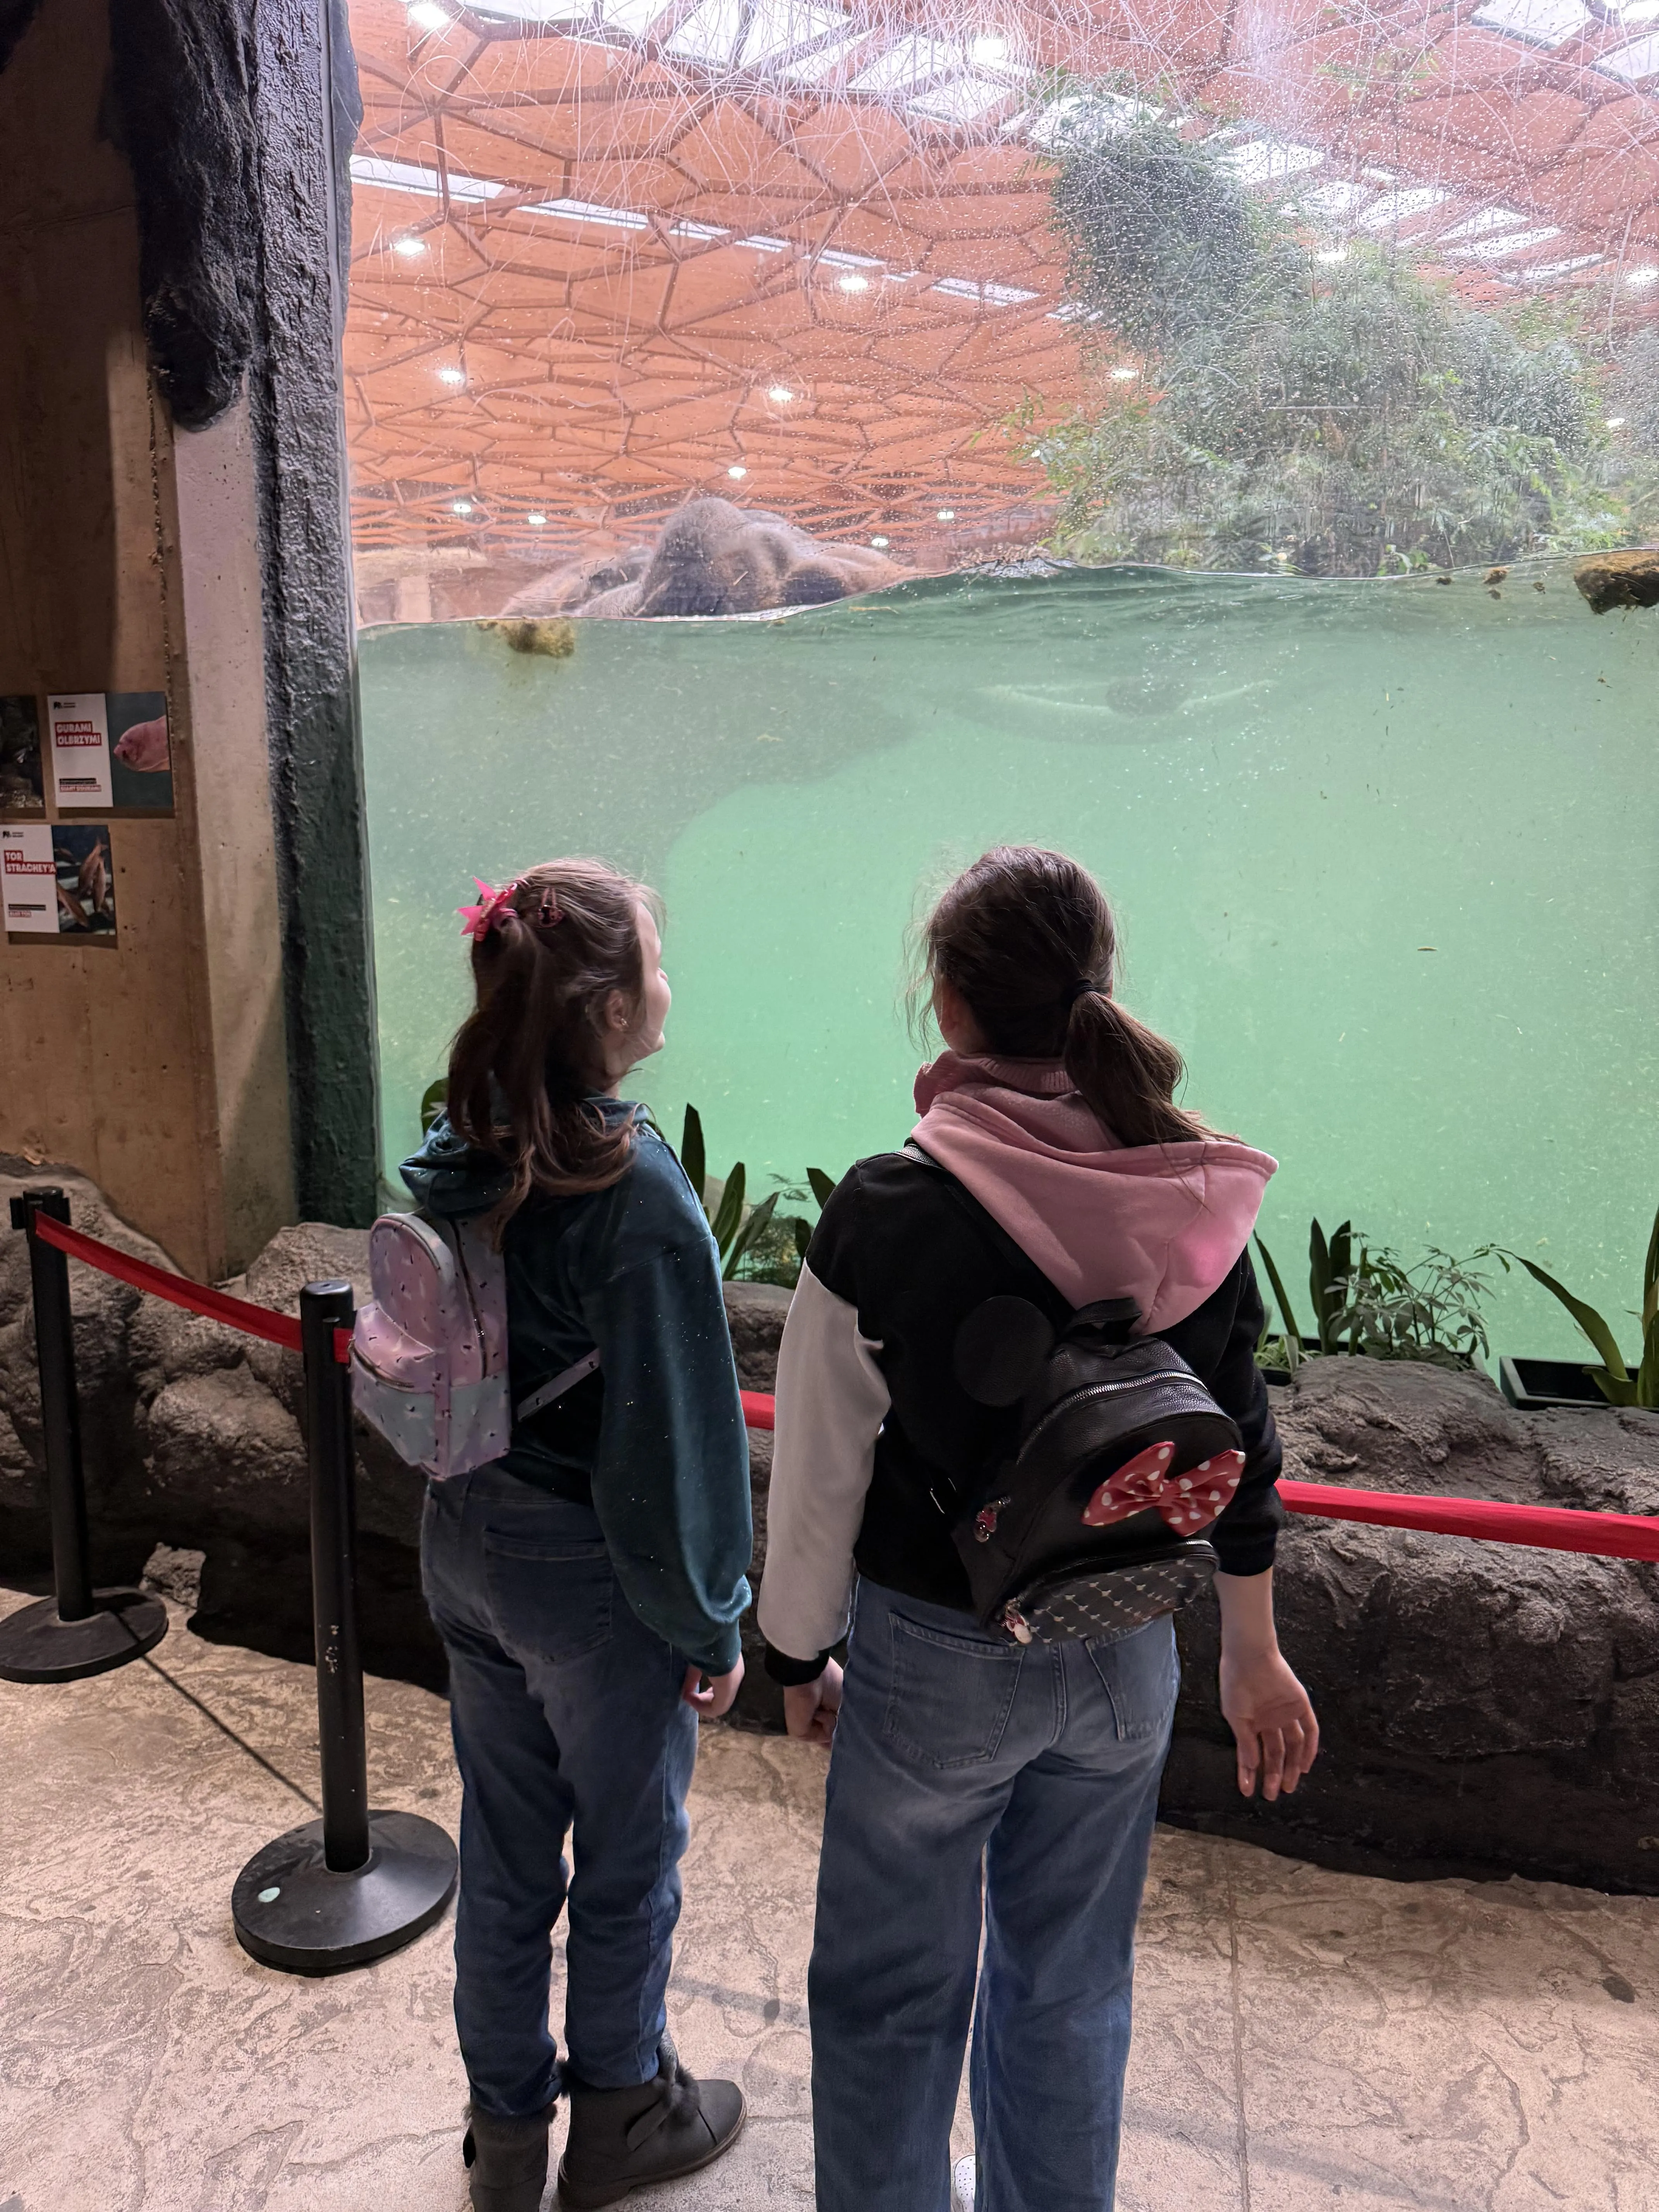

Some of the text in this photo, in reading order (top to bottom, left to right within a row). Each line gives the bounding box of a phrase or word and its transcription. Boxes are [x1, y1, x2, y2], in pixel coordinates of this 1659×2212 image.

[57, 723, 91, 733] GURAMI
[57, 735, 101, 745] OLBRZYMI
[5, 852, 22, 862] TOR
[6, 864, 56, 873] STRACHEY'A
